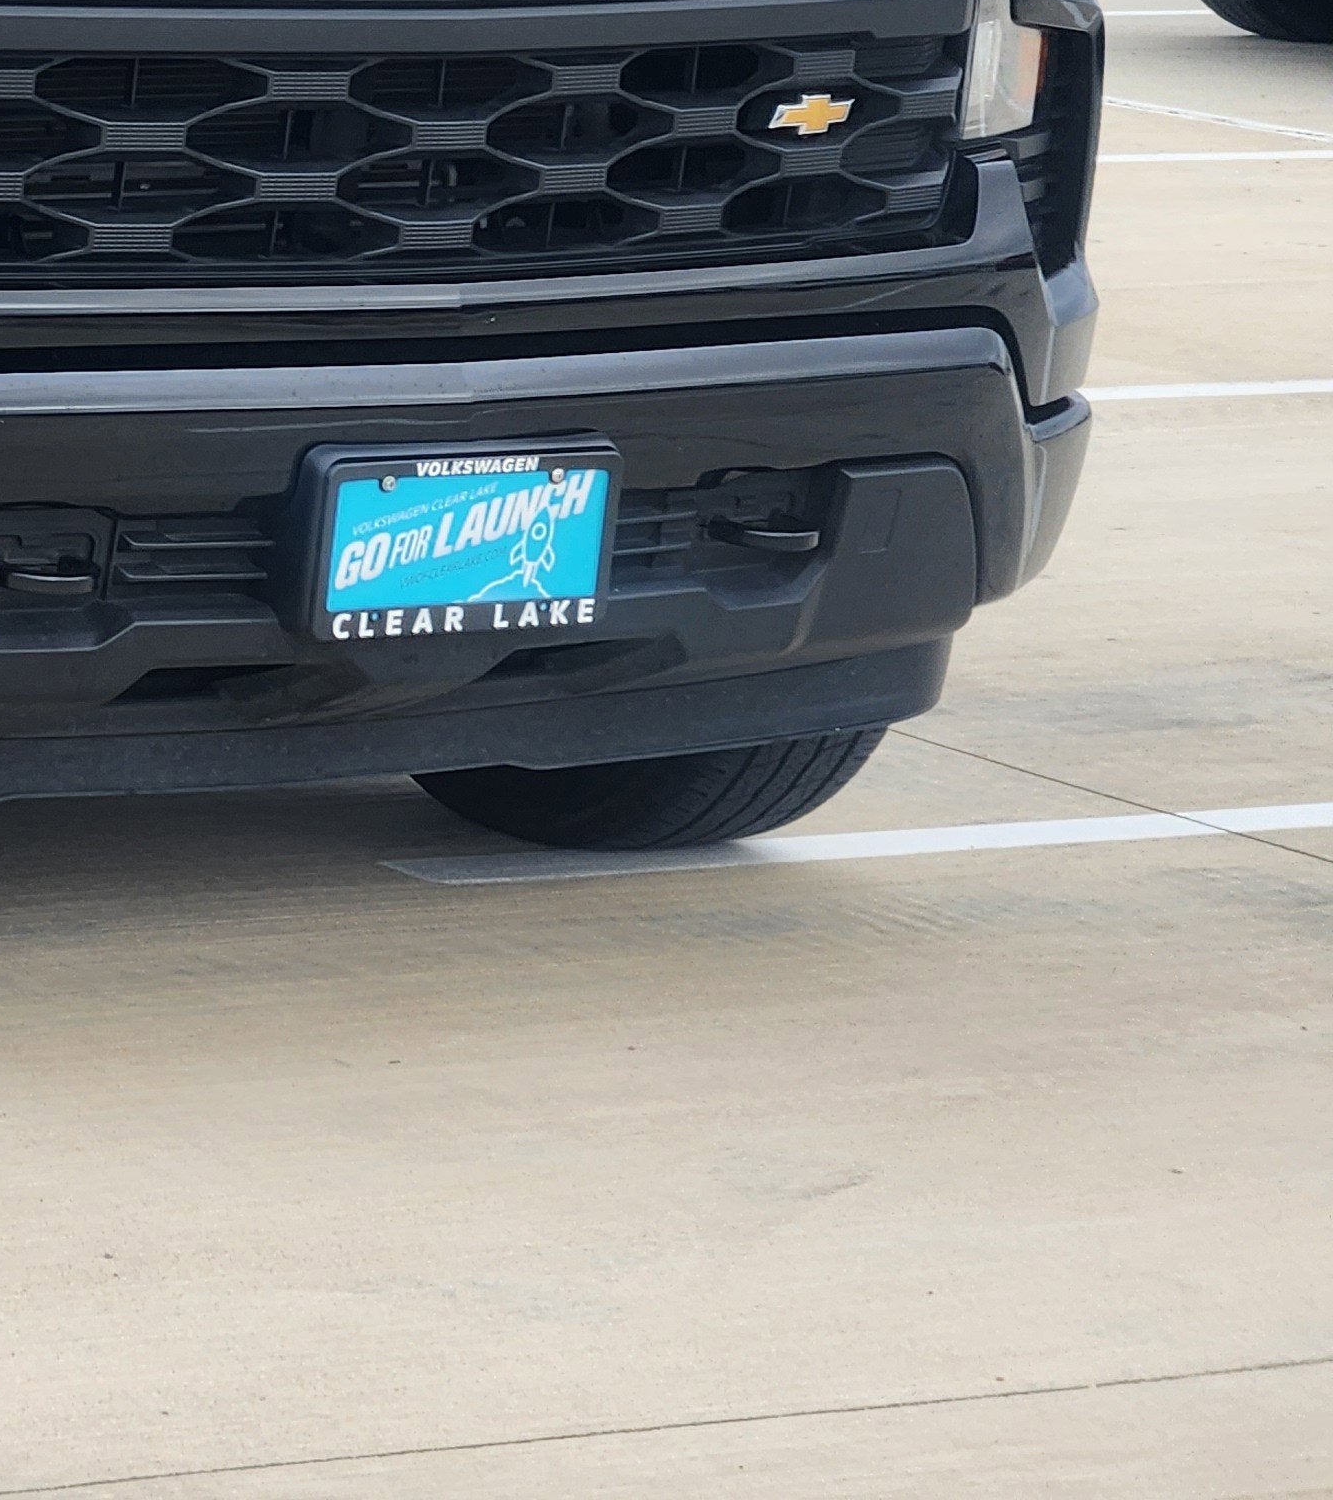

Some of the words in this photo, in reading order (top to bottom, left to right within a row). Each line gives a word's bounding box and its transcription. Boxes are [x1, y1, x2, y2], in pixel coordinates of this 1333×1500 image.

[416, 456, 540, 478] VOLKSWAGEN
[335, 532, 393, 591] GO
[388, 523, 432, 569] FOR
[433, 469, 595, 557] LAUNCH
[352, 505, 429, 537] VOLKSWAGEN
[431, 492, 467, 512] CLEAR
[468, 482, 500, 501] LAKE
[332, 605, 466, 640] CLEAR
[493, 599, 596, 629] LAKE
